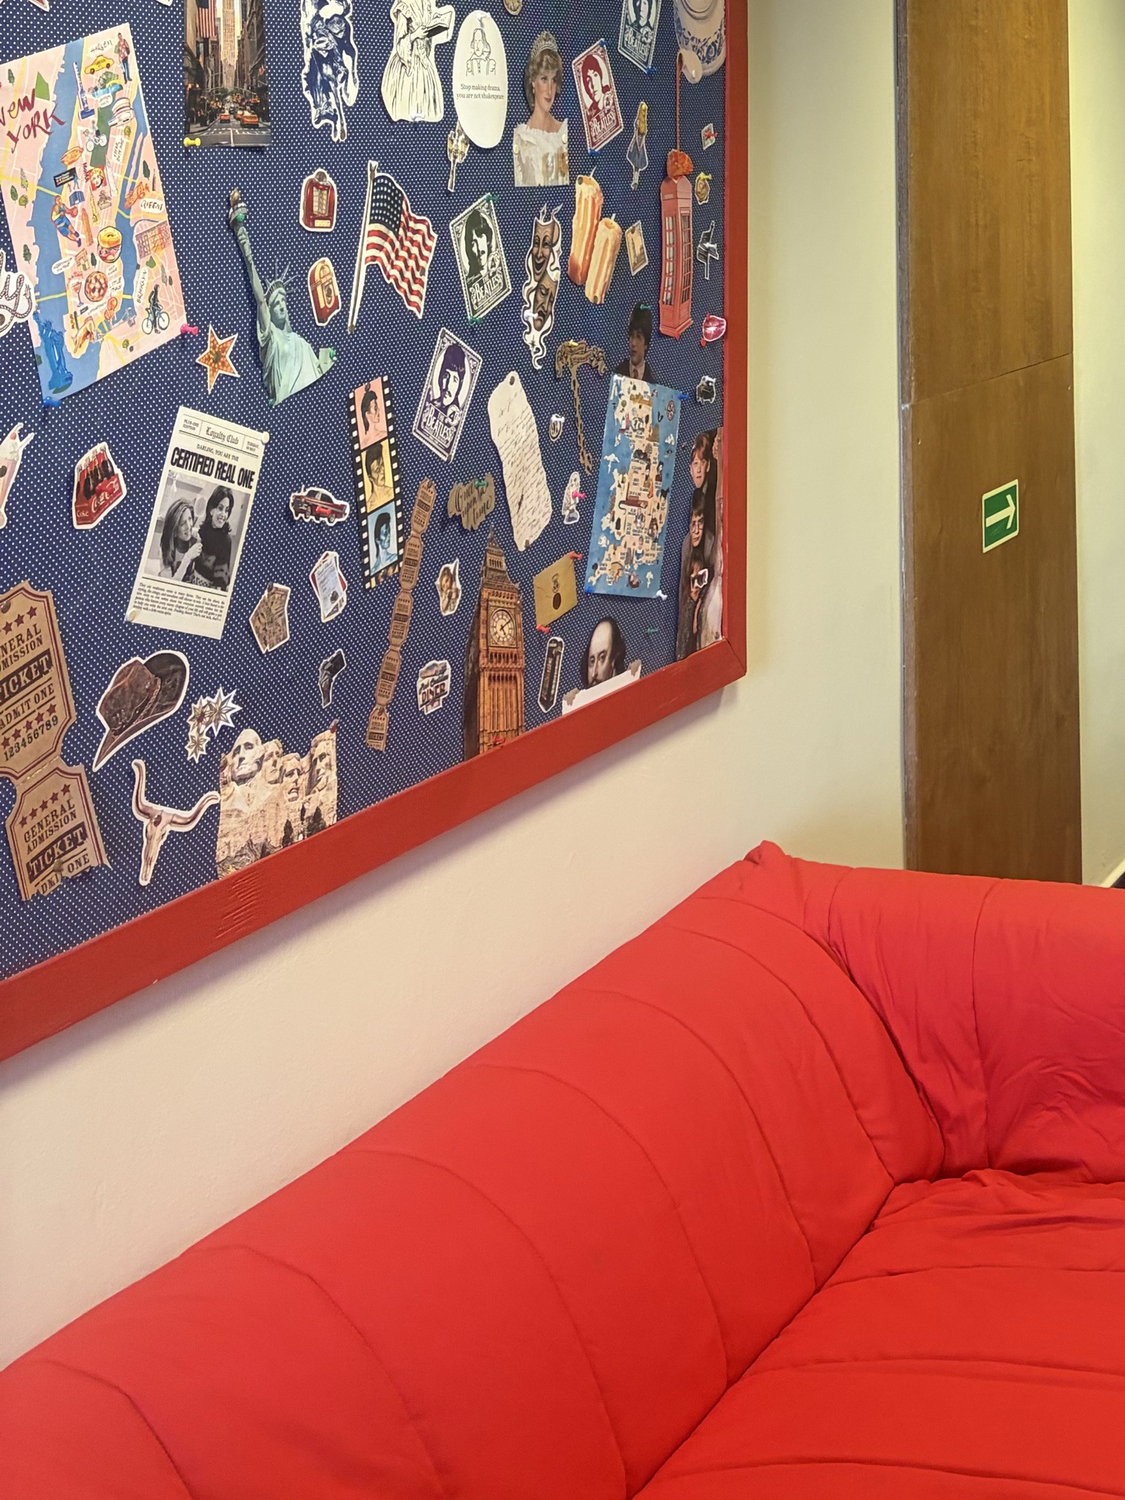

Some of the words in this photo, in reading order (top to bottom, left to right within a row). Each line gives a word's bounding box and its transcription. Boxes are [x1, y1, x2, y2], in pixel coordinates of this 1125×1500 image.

[460, 84, 471, 92] Stop
[141, 200, 164, 211] QUEENS
[206, 427, 226, 442] Loyalty
[226, 433, 240, 445] Club
[170, 446, 216, 477] CERTIFIED
[214, 460, 237, 485] REAL
[237, 467, 256, 490] ONE
[76, 510, 89, 518] Coke
[0, 655, 49, 699] ICKET
[34, 682, 55, 705] ONE
[4, 714, 59, 762] 123456789
[23, 799, 75, 844] GENERAL
[27, 808, 77, 855] ADMISSION
[30, 826, 85, 877] TICKET
[67, 853, 90, 873] ONE
